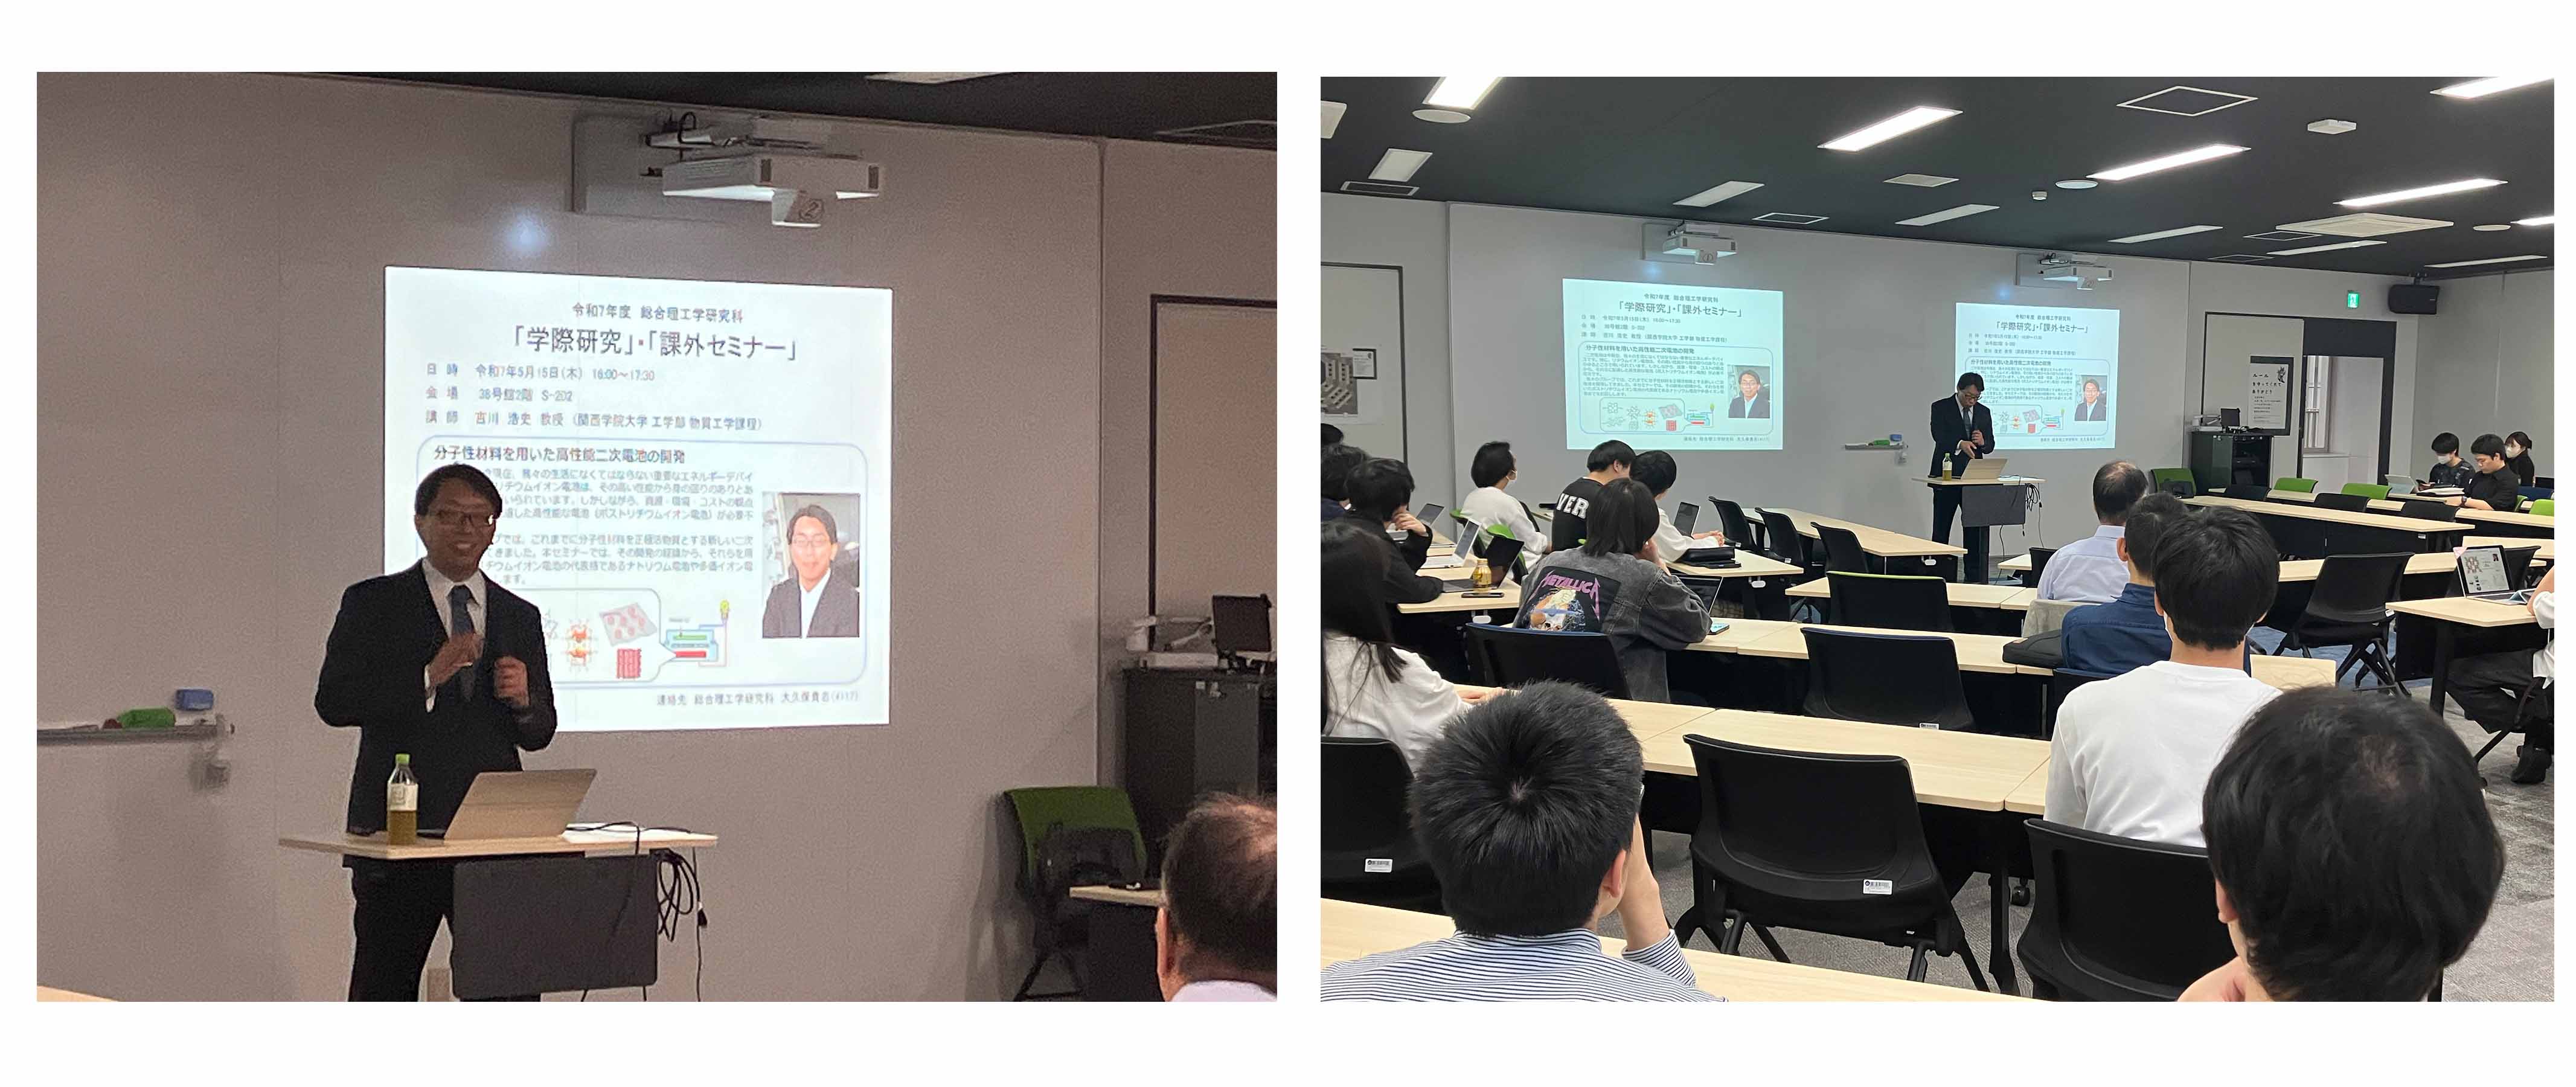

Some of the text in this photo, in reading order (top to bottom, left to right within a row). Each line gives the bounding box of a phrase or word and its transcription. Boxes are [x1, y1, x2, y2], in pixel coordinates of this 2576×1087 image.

[572, 303, 743, 323] 令和7年度 総合理工学研究科
[1527, 569, 1601, 621] METALLICA
